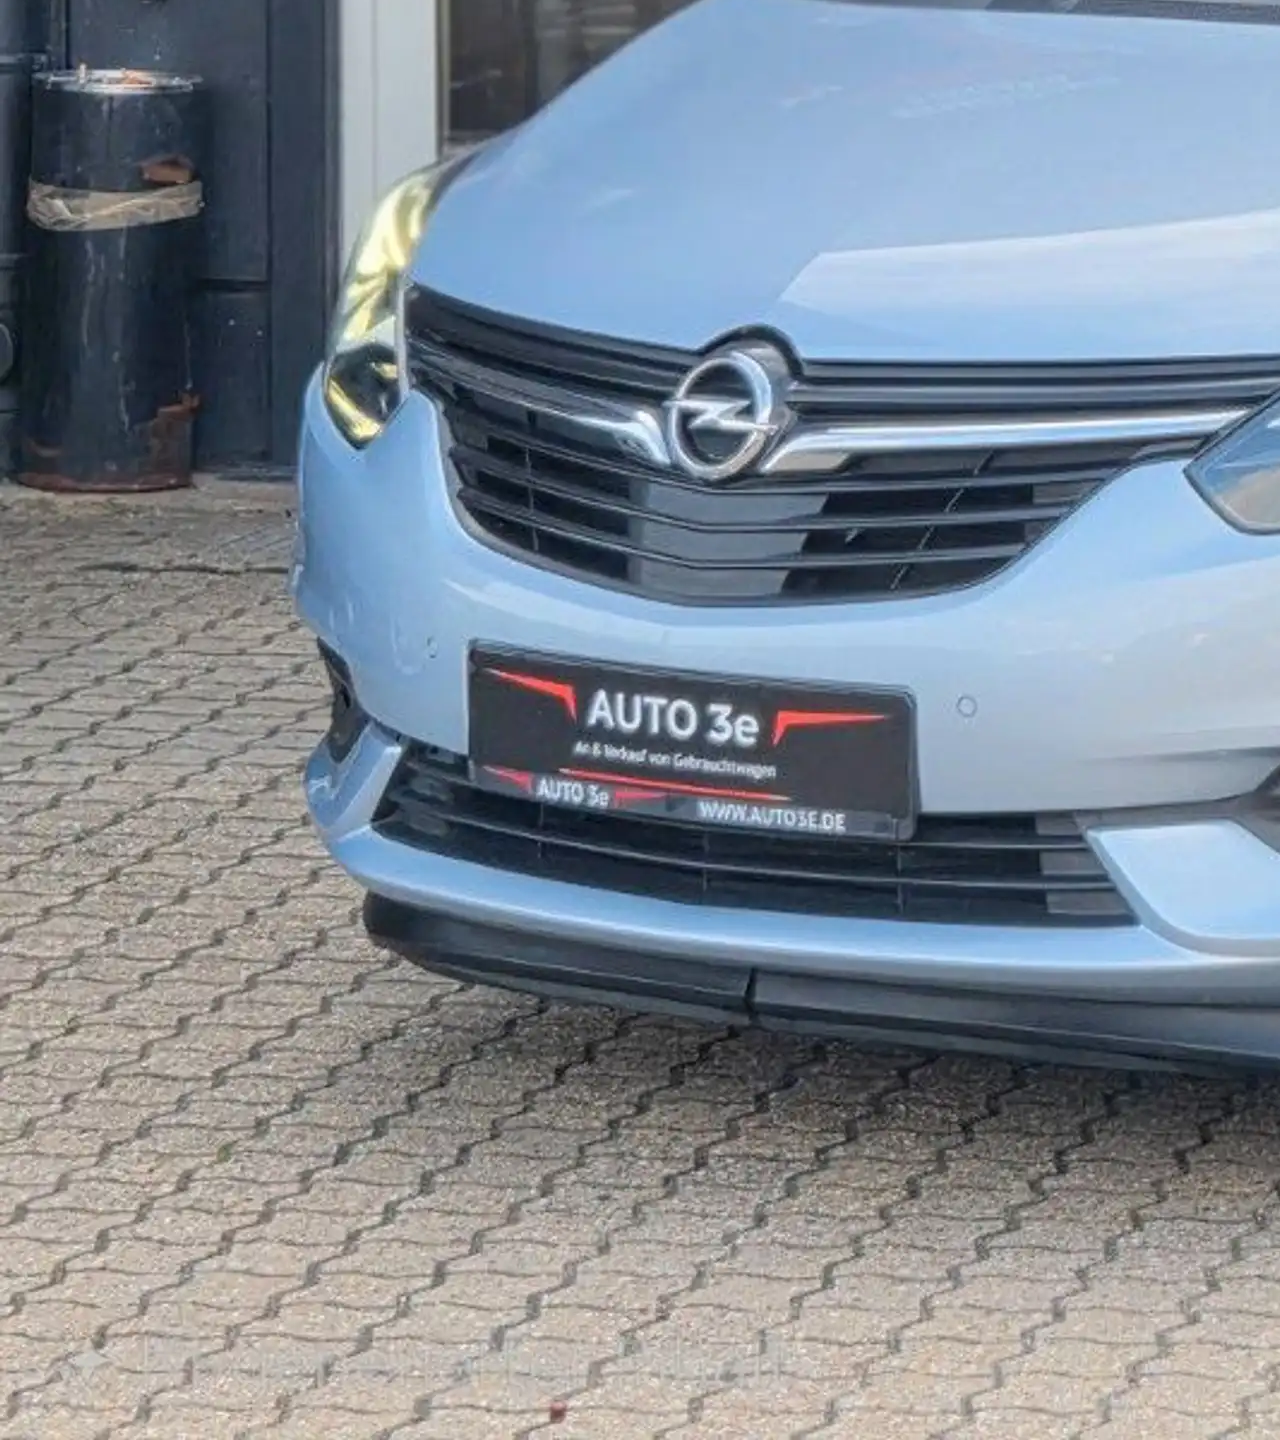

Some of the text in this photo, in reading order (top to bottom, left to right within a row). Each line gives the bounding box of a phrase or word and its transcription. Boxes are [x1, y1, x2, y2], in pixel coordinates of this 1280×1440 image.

[587, 688, 760, 747] AUTO 3e
[649, 752, 671, 766] von
[673, 753, 777, 781] Gebrauchtwagen
[536, 776, 610, 808] AUTO 3e
[697, 799, 848, 834] WWW.AUTO3E.DE
